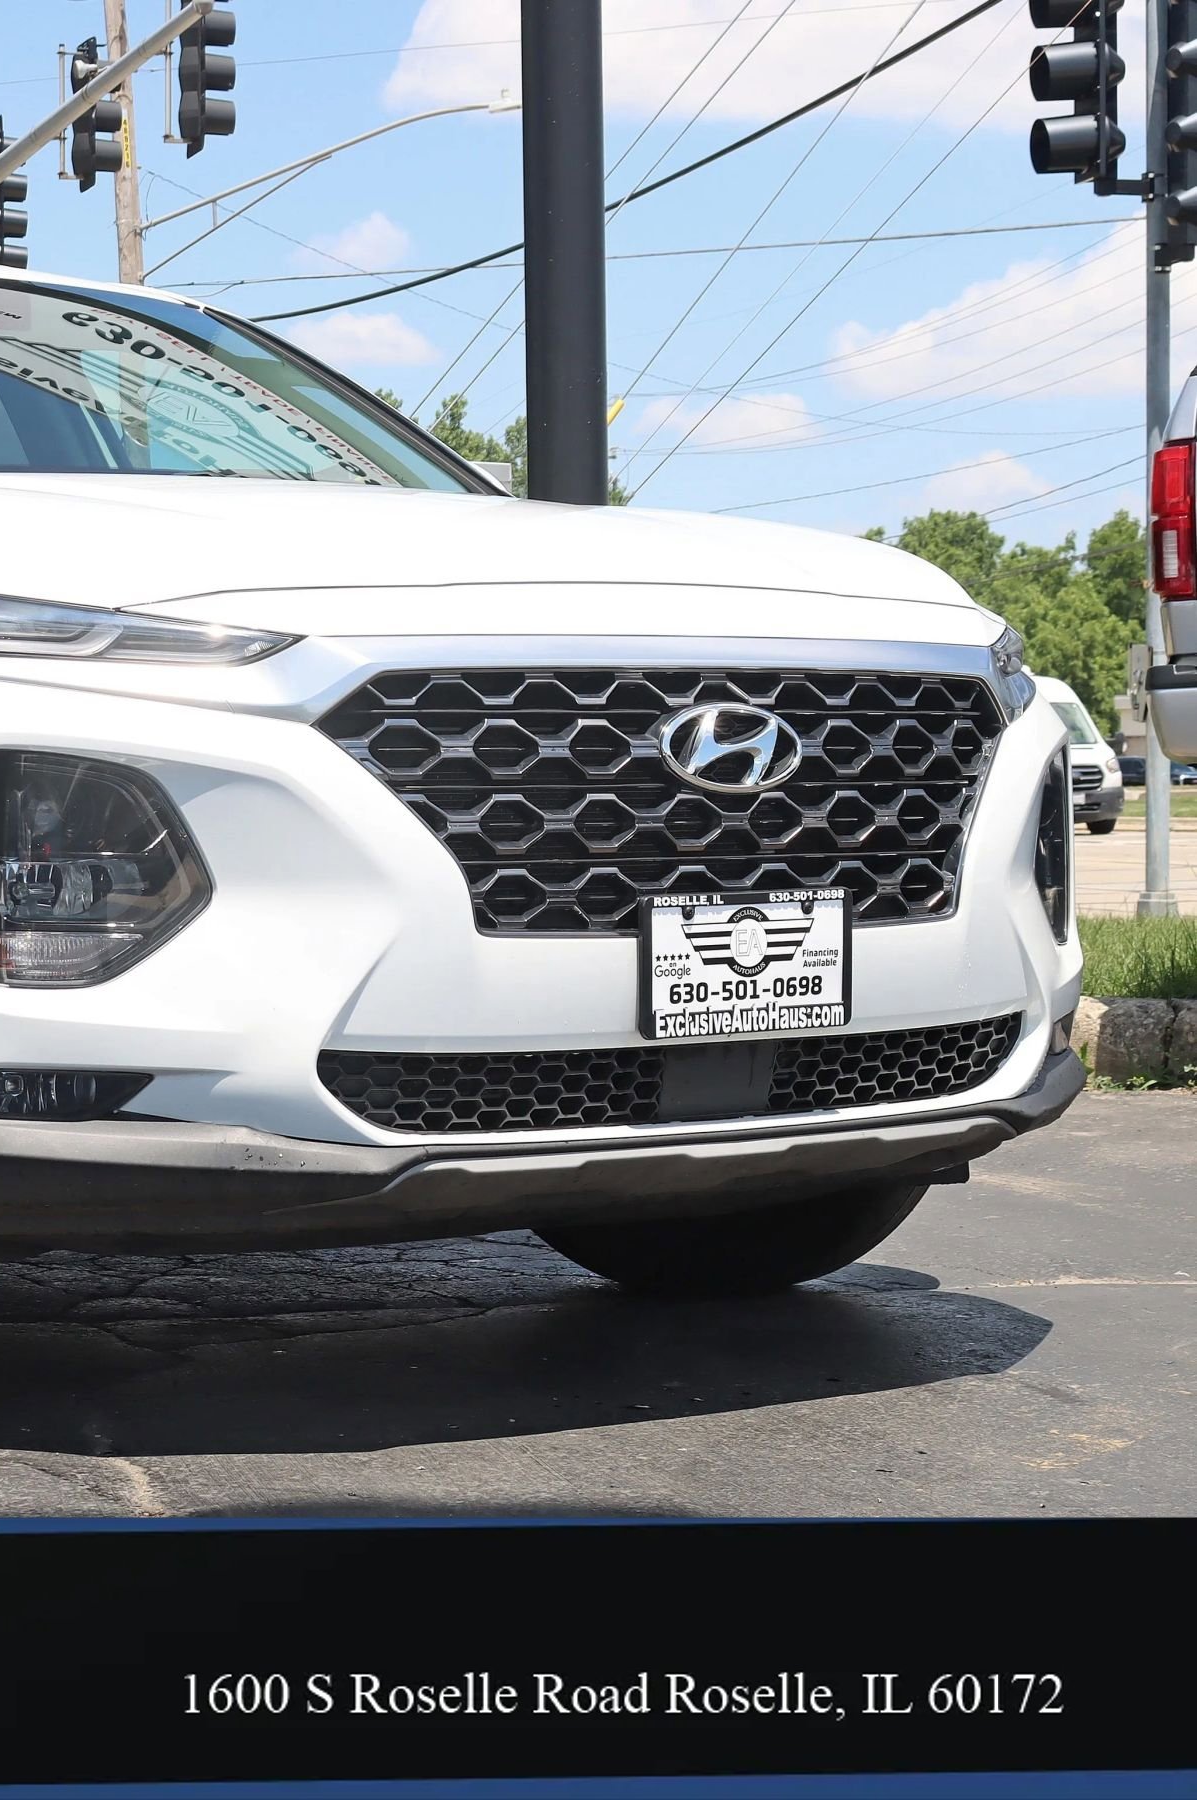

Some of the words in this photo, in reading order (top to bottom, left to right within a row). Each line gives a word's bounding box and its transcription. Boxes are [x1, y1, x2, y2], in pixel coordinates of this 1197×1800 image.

[654, 895, 710, 907] ROSELLE,
[712, 894, 725, 906] IL
[769, 889, 845, 903] 630-501-0698
[733, 908, 763, 922] EXCLUSIVE
[735, 929, 763, 957] EA
[802, 948, 839, 960] Financing
[732, 961, 766, 976] AUTOHAUS
[802, 958, 838, 968] Available
[654, 964, 691, 980] Google
[669, 975, 823, 1005] 630-501-0698
[655, 1002, 844, 1038] ExclusiveAutoHaus.com
